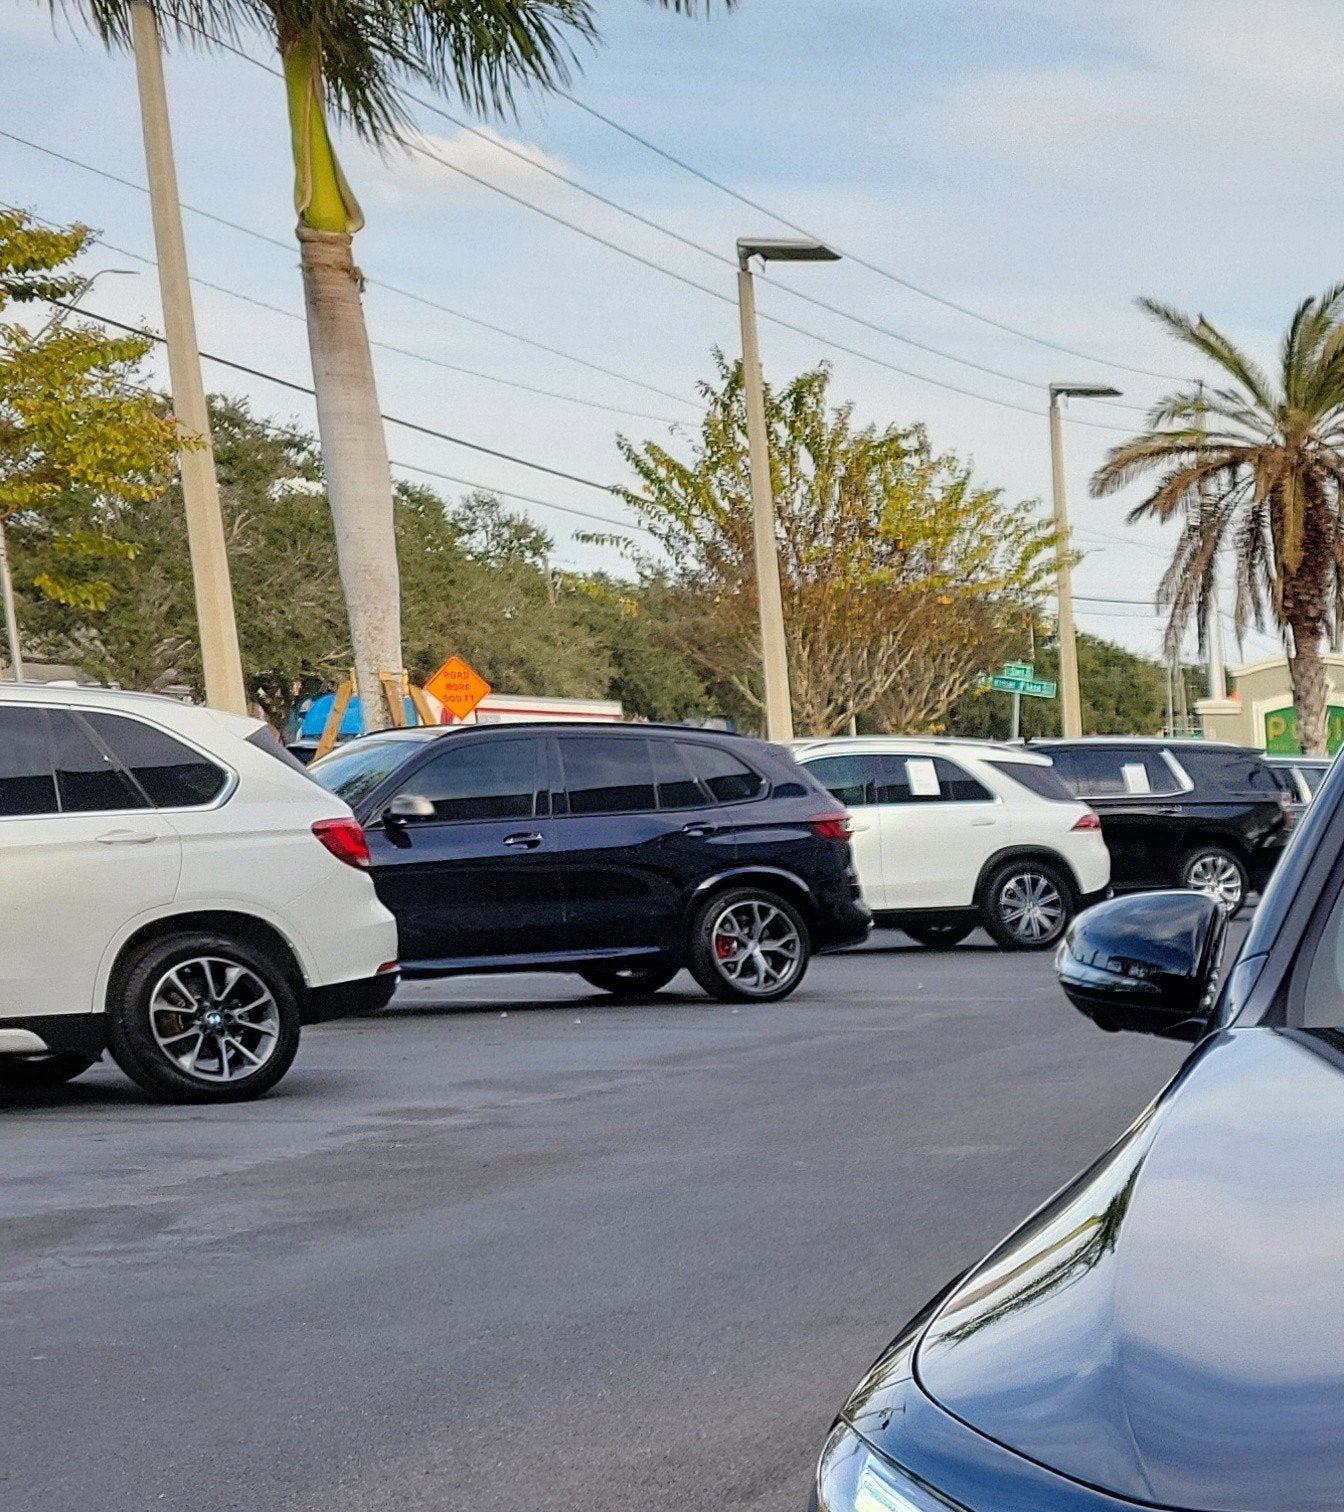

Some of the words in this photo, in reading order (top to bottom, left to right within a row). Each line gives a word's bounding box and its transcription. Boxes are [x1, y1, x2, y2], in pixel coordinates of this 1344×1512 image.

[443, 671, 470, 680] ROAD
[445, 683, 470, 691] WORK
[443, 695, 462, 703] 500
